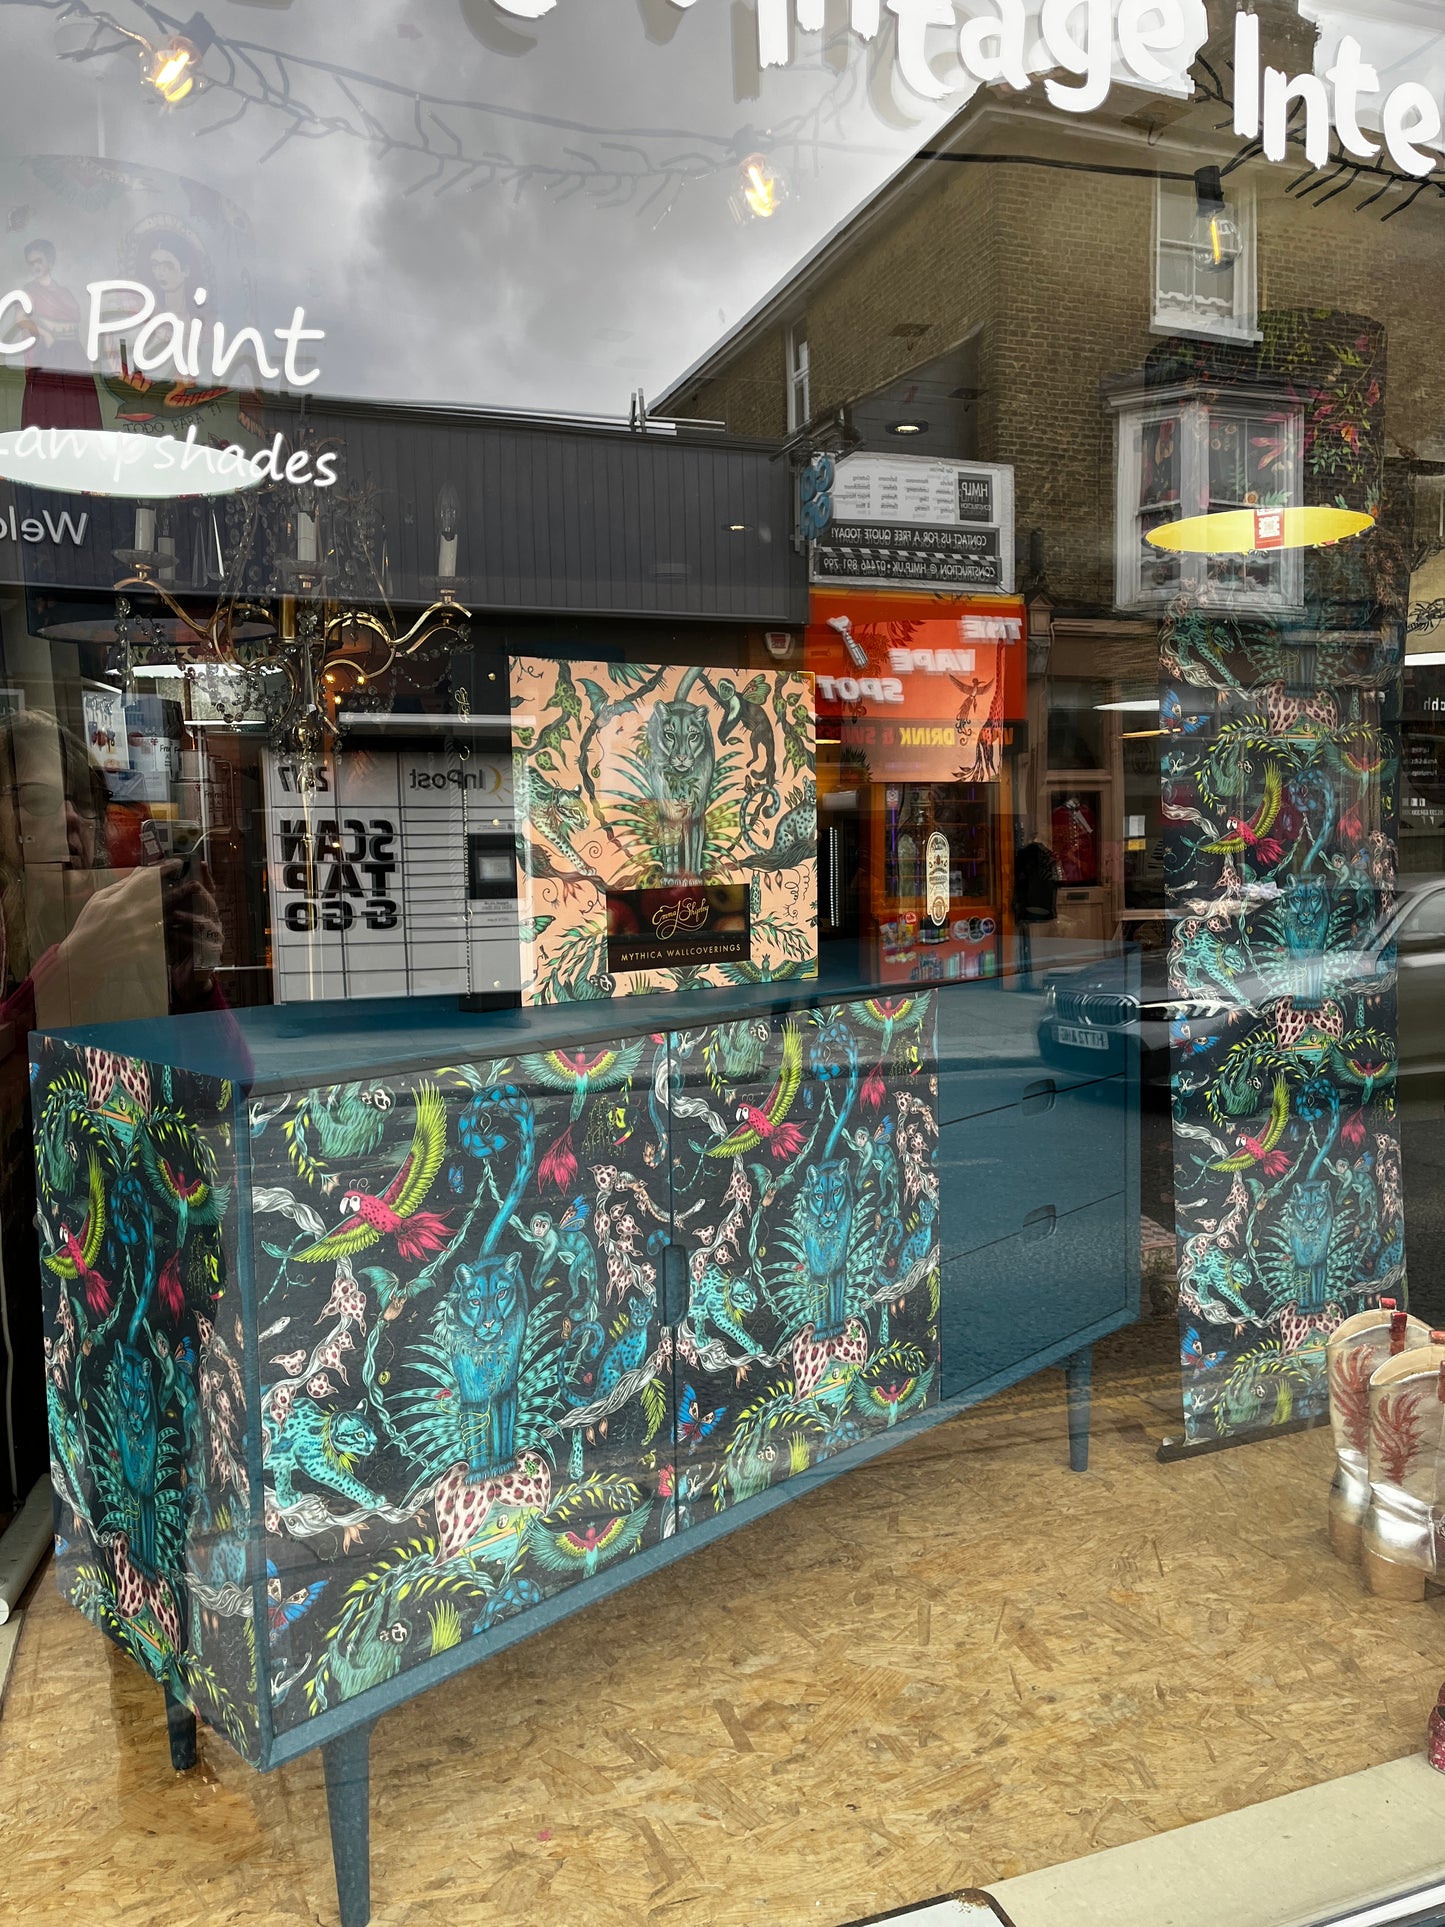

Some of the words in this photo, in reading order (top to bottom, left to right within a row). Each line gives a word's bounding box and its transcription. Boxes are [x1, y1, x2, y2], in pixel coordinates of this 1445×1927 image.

[1233, 12, 1440, 178] Inte
[86, 280, 325, 386] Paint
[123, 422, 165, 434] TODO
[171, 414, 205, 431] PARA
[208, 402, 222, 416] TI
[0, 425, 337, 487] ampshades
[620, 950, 663, 962] MYTHICA
[666, 943, 741, 957] WALLCOVERINGS
